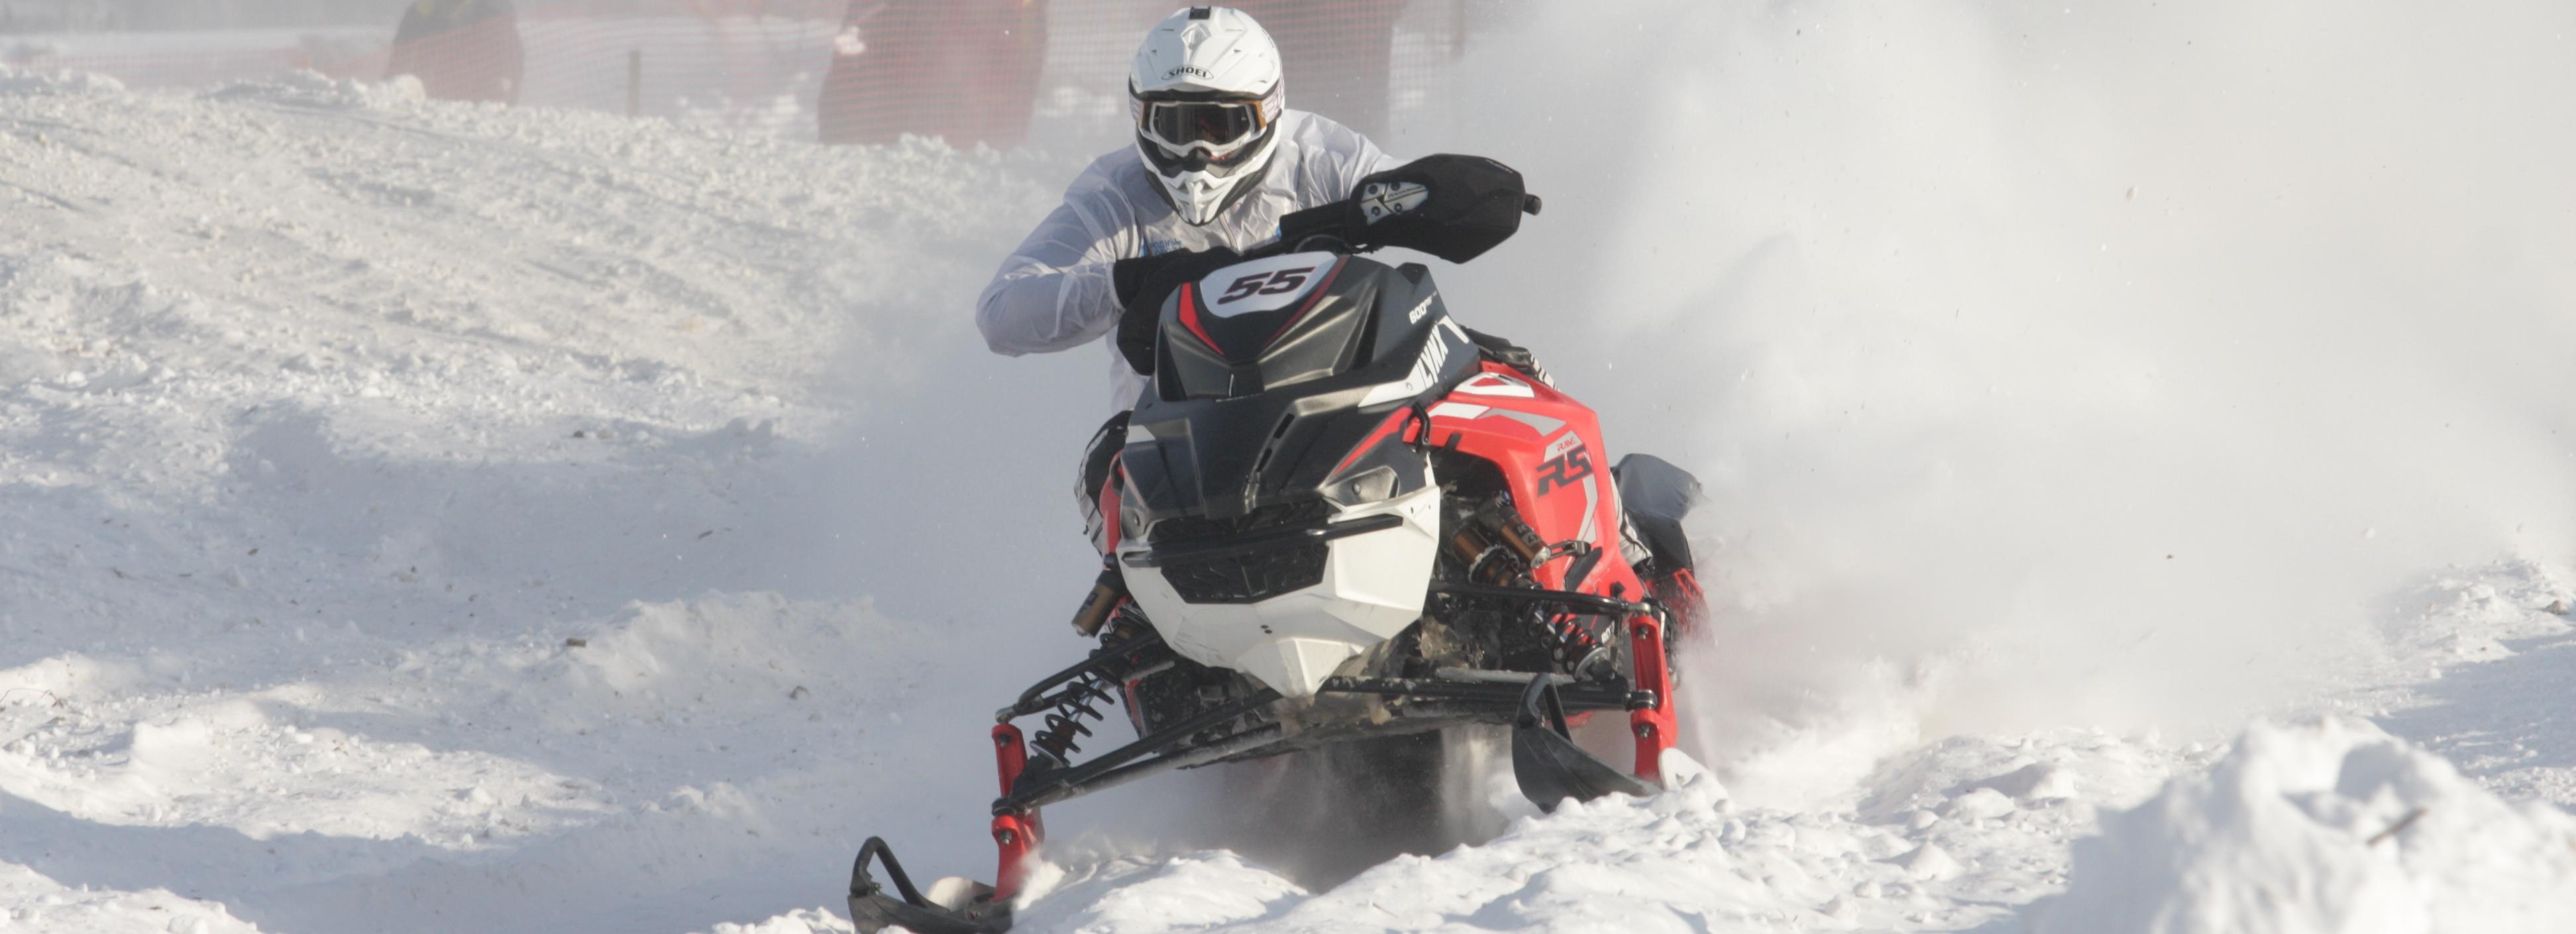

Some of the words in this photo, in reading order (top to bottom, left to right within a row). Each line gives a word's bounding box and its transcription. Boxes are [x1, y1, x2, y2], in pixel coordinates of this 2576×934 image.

[1169, 67, 1207, 78] SHOEI
[1217, 266, 1316, 305] 55
[1417, 323, 1449, 388] LYNX
[1536, 443, 1593, 497] RS
[1601, 620, 1615, 643] ROT
